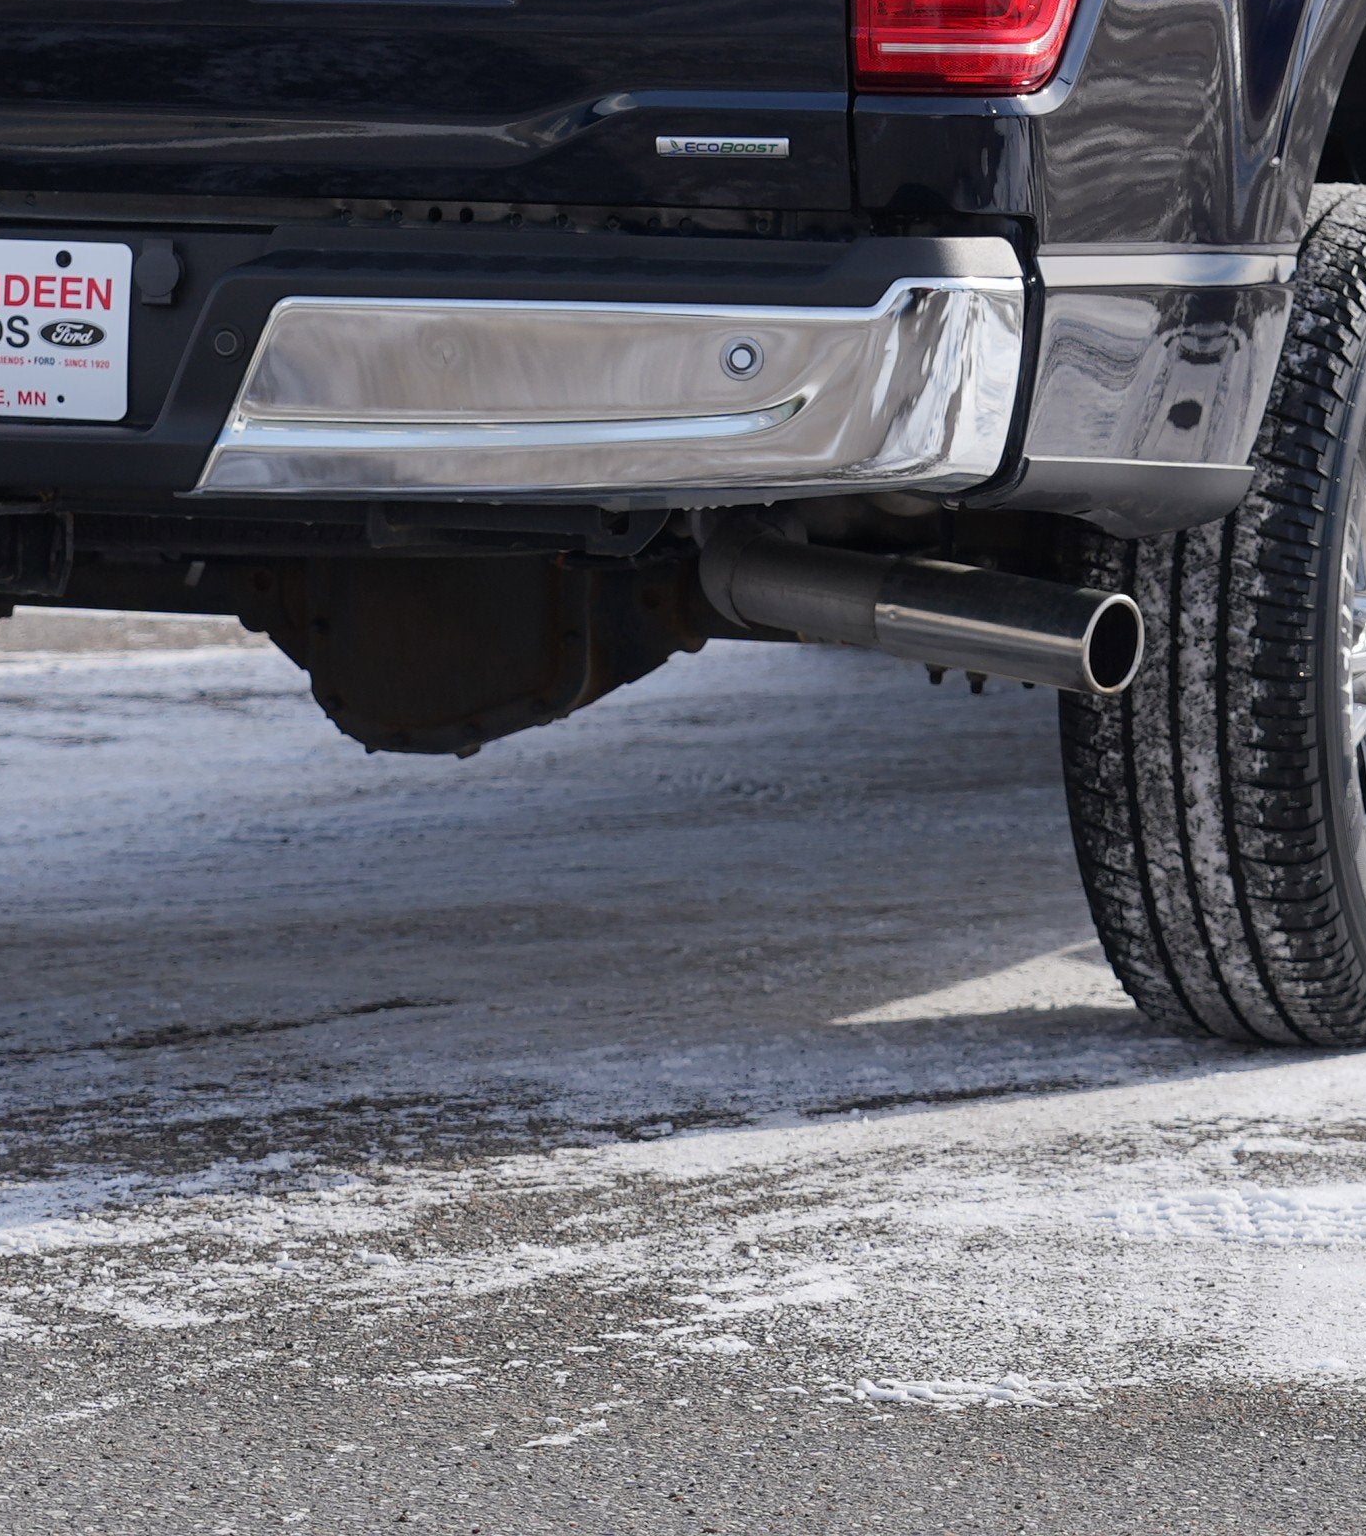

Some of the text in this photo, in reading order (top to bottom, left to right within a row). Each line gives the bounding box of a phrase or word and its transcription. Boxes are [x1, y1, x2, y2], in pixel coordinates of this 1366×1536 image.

[51, 322, 95, 345] Ford
[34, 356, 56, 366] FORD
[64, 358, 88, 369] SINCE
[91, 360, 111, 369] 1920
[17, 391, 47, 406] MN
